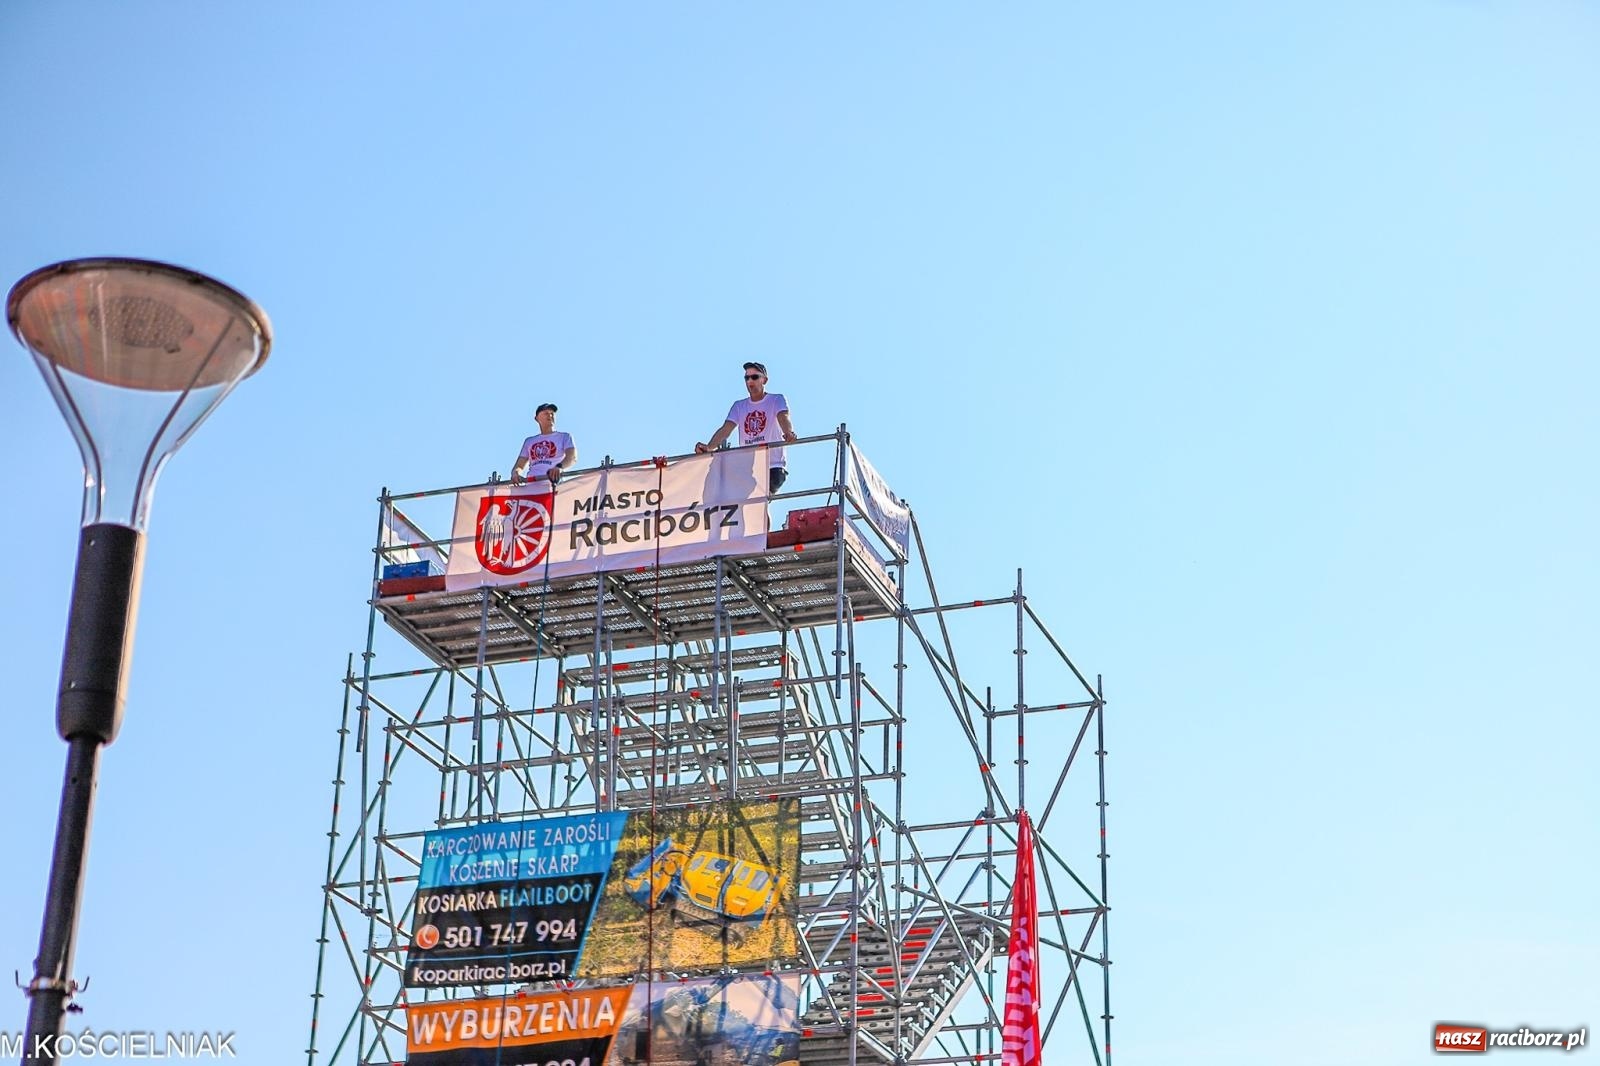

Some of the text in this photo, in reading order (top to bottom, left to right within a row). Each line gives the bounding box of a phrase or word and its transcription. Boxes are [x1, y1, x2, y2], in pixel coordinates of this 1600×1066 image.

[573, 489, 664, 516] MIASTO
[570, 502, 739, 550] Racibórz
[427, 817, 610, 859] KARCZOWANIE ZAROŚLI
[449, 853, 579, 883] KOSZENIE SKARP
[417, 883, 592, 915] KOSIARKA FLAILBOOT
[444, 918, 577, 948] 501 747 994
[414, 959, 566, 984] koparkiracborz.pl
[411, 996, 615, 1045] WYBURZENIA
